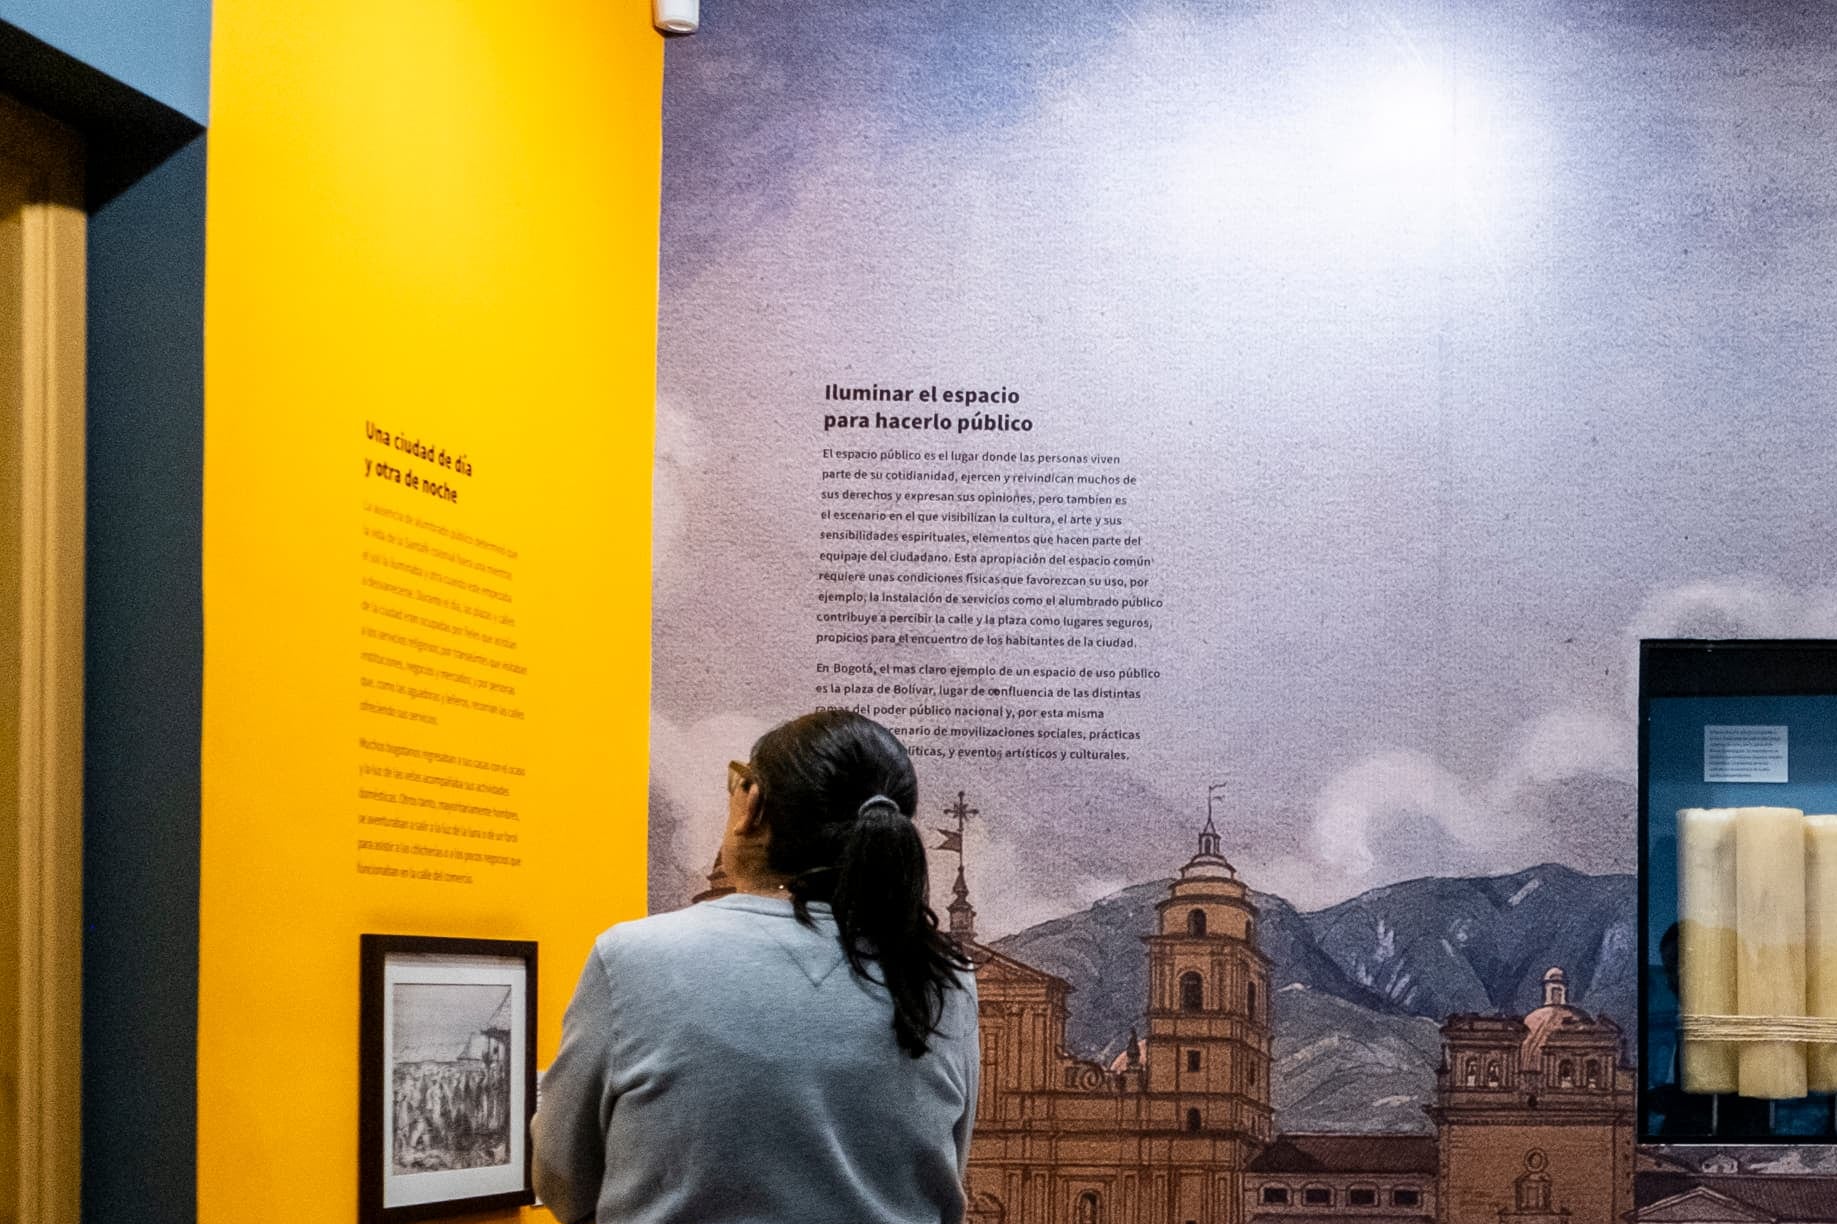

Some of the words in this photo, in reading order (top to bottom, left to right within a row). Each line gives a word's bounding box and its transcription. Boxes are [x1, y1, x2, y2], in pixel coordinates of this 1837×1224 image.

[825, 384, 914, 401] Iluminar
[919, 386, 937, 401] el
[942, 386, 1020, 406] espacio
[824, 414, 869, 431] para
[876, 412, 952, 429] hacerlo
[958, 411, 1033, 434] público
[366, 419, 390, 446] Una
[394, 432, 435, 463] ciudad
[438, 448, 451, 470] de
[822, 448, 833, 458] El
[835, 448, 878, 462] espacio
[880, 449, 921, 462] público
[924, 452, 936, 460] es
[938, 450, 948, 460] el
[951, 450, 979, 463] lugar
[982, 451, 1017, 461] donde
[1019, 451, 1035, 462] las
[1037, 454, 1088, 465] personas
[1091, 453, 1120, 463] viven
[365, 458, 372, 478] y
[376, 462, 401, 484] otra
[405, 468, 419, 490] de
[423, 482, 457, 504] noche
[822, 470, 851, 482] parte
[854, 469, 868, 479] de
[870, 472, 883, 480] su
[885, 470, 958, 482] cotidianidad,
[961, 471, 1001, 484] ejercen
[1004, 474, 1011, 485] y
[1012, 472, 1074, 483] reivindican
[1077, 473, 1120, 484] muchos
[1123, 474, 1137, 484] de
[821, 491, 839, 499] sus
[842, 489, 893, 500] derechos
[895, 493, 902, 503] y
[904, 493, 955, 504] expresan
[957, 494, 975, 502] sus
[1038, 495, 1064, 506] pero
[1115, 497, 1127, 505] es
[821, 509, 831, 520] el
[833, 510, 887, 520] escenario
[888, 513, 903, 521] en
[905, 511, 915, 521] el
[917, 513, 938, 524] que
[941, 511, 996, 522] visibilizan
[999, 512, 1009, 523] la
[1011, 513, 1055, 525] cultura,
[1057, 513, 1067, 524] el
[1070, 515, 1092, 524] arte
[1095, 516, 1101, 527] y
[1104, 517, 1122, 525] sus
[820, 530, 898, 541] sensibilidades
[901, 531, 969, 545] espirituales,
[972, 532, 1030, 543] elementos
[1033, 536, 1053, 546] que
[1056, 534, 1089, 544] hacen
[1092, 536, 1121, 547] parte
[1124, 535, 1142, 545] del
[819, 551, 867, 564] equipaje
[870, 551, 887, 562] del
[890, 552, 951, 562] ciudadano.
[954, 553, 977, 563] Esta
[980, 553, 1046, 567] apropiación
[1049, 554, 1066, 564] del
[1068, 554, 1111, 568] espacio
[818, 571, 865, 584] requiere
[868, 574, 895, 582] unas
[896, 572, 963, 583] condiciones
[1002, 576, 1023, 587] que
[1026, 574, 1086, 585] favorezcan
[1089, 578, 1101, 586] su
[1104, 578, 1127, 588] uso,
[1130, 579, 1148, 589] por
[818, 591, 866, 604] ejemplo,
[869, 592, 879, 602] la
[882, 592, 942, 603] instalación
[945, 593, 958, 603] de
[961, 593, 1010, 604] servicios
[1012, 597, 1043, 605] como
[1046, 595, 1056, 605] el
[1058, 595, 1119, 606] alumbrado
[1121, 596, 1163, 610] público
[816, 611, 877, 625] contribuye
[880, 615, 887, 623] a
[889, 613, 932, 626] percibir
[935, 613, 945, 624] la
[948, 614, 973, 624] calle
[976, 616, 982, 627] y
[985, 614, 995, 625] la
[998, 614, 1027, 628] plaza
[1030, 618, 1060, 626] como
[1063, 616, 1103, 629] lugares
[1106, 619, 1152, 630] seguros,
[816, 632, 868, 646] propicios
[871, 636, 896, 646] para
[898, 633, 909, 644] el
[910, 635, 968, 644] encuentro
[970, 634, 984, 645] de
[986, 635, 1003, 645] los
[1005, 635, 1065, 646] habitantes
[1067, 636, 1081, 646] de
[1083, 636, 1093, 646] la
[1096, 636, 1136, 647] ciudad.
[816, 662, 829, 672] En
[833, 662, 878, 676] Bogotá,
[879, 663, 890, 673] el
[919, 664, 947, 674] claro
[949, 664, 996, 678] ejemplo
[999, 665, 1013, 675] de
[1016, 668, 1030, 676] un
[1032, 666, 1076, 679] espacio
[1079, 666, 1093, 677] de
[1095, 669, 1116, 677] uso
[1119, 667, 1161, 680] público
[815, 685, 828, 693] es
[830, 683, 841, 693] la
[843, 683, 874, 696] plaza
[876, 684, 890, 694] de
[893, 684, 936, 696] Bolívar,
[939, 685, 968, 698] lugar
[970, 685, 985, 696] de
[1056, 687, 1070, 697] de
[1073, 687, 1089, 697] las
[1091, 687, 1141, 698] distintas
[853, 704, 870, 715] del
[873, 705, 907, 718] poder
[909, 705, 951, 718] público
[954, 706, 1003, 716] nacional
[1006, 709, 1015, 719] y,
[1017, 709, 1038, 720] por
[1040, 708, 1064, 717] esta
[1066, 707, 1104, 718] misma
[888, 725, 931, 735] cenario
[933, 725, 947, 736] de
[950, 726, 1035, 737] movilizaciones
[1037, 727, 1086, 739] sociales,
[1089, 728, 1140, 741] prácticas
[907, 745, 946, 757] líticas,
[948, 748, 955, 759] y
[1005, 747, 1057, 758] artísticos
[1060, 750, 1067, 761] y
[1070, 748, 1129, 759] culturales.
